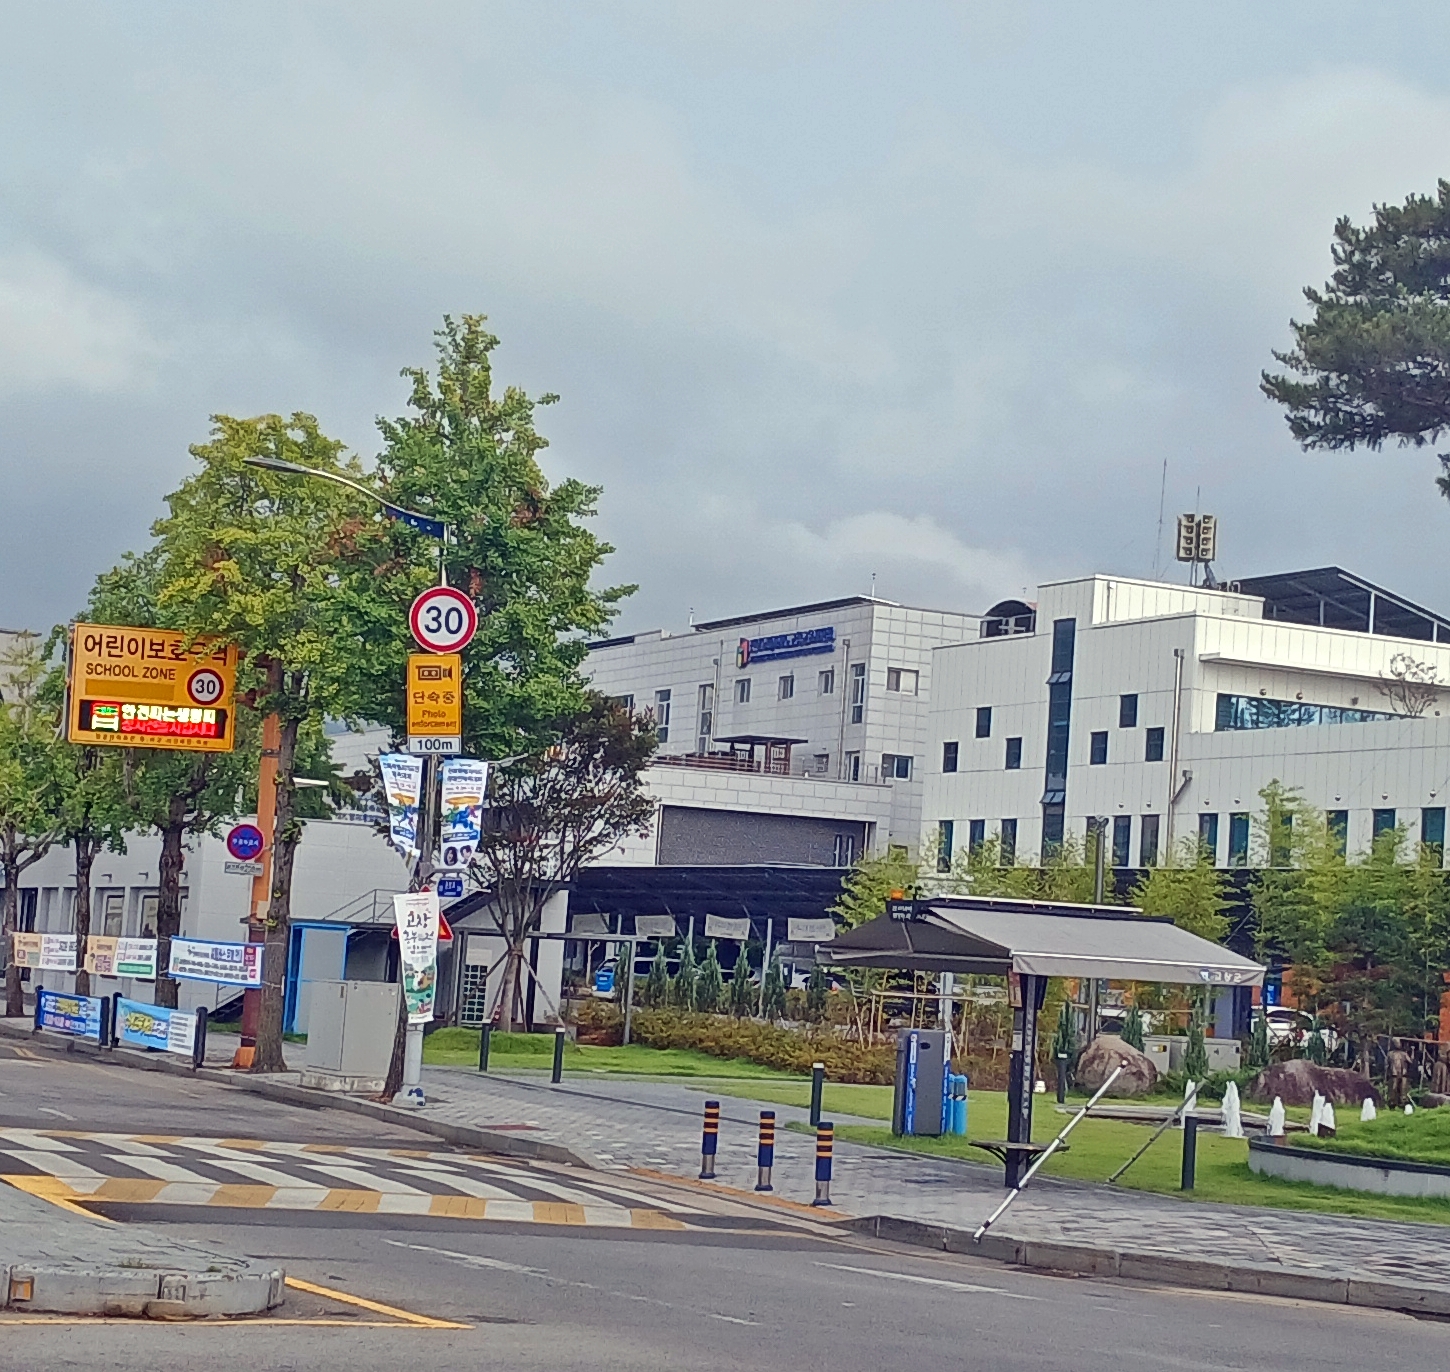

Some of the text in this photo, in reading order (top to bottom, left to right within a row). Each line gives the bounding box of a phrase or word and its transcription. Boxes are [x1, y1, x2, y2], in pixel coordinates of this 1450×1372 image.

[424, 605, 463, 634] 30
[86, 663, 176, 680] SCHOOL ZONE
[195, 679, 216, 694] 30
[417, 739, 453, 751] 100m
